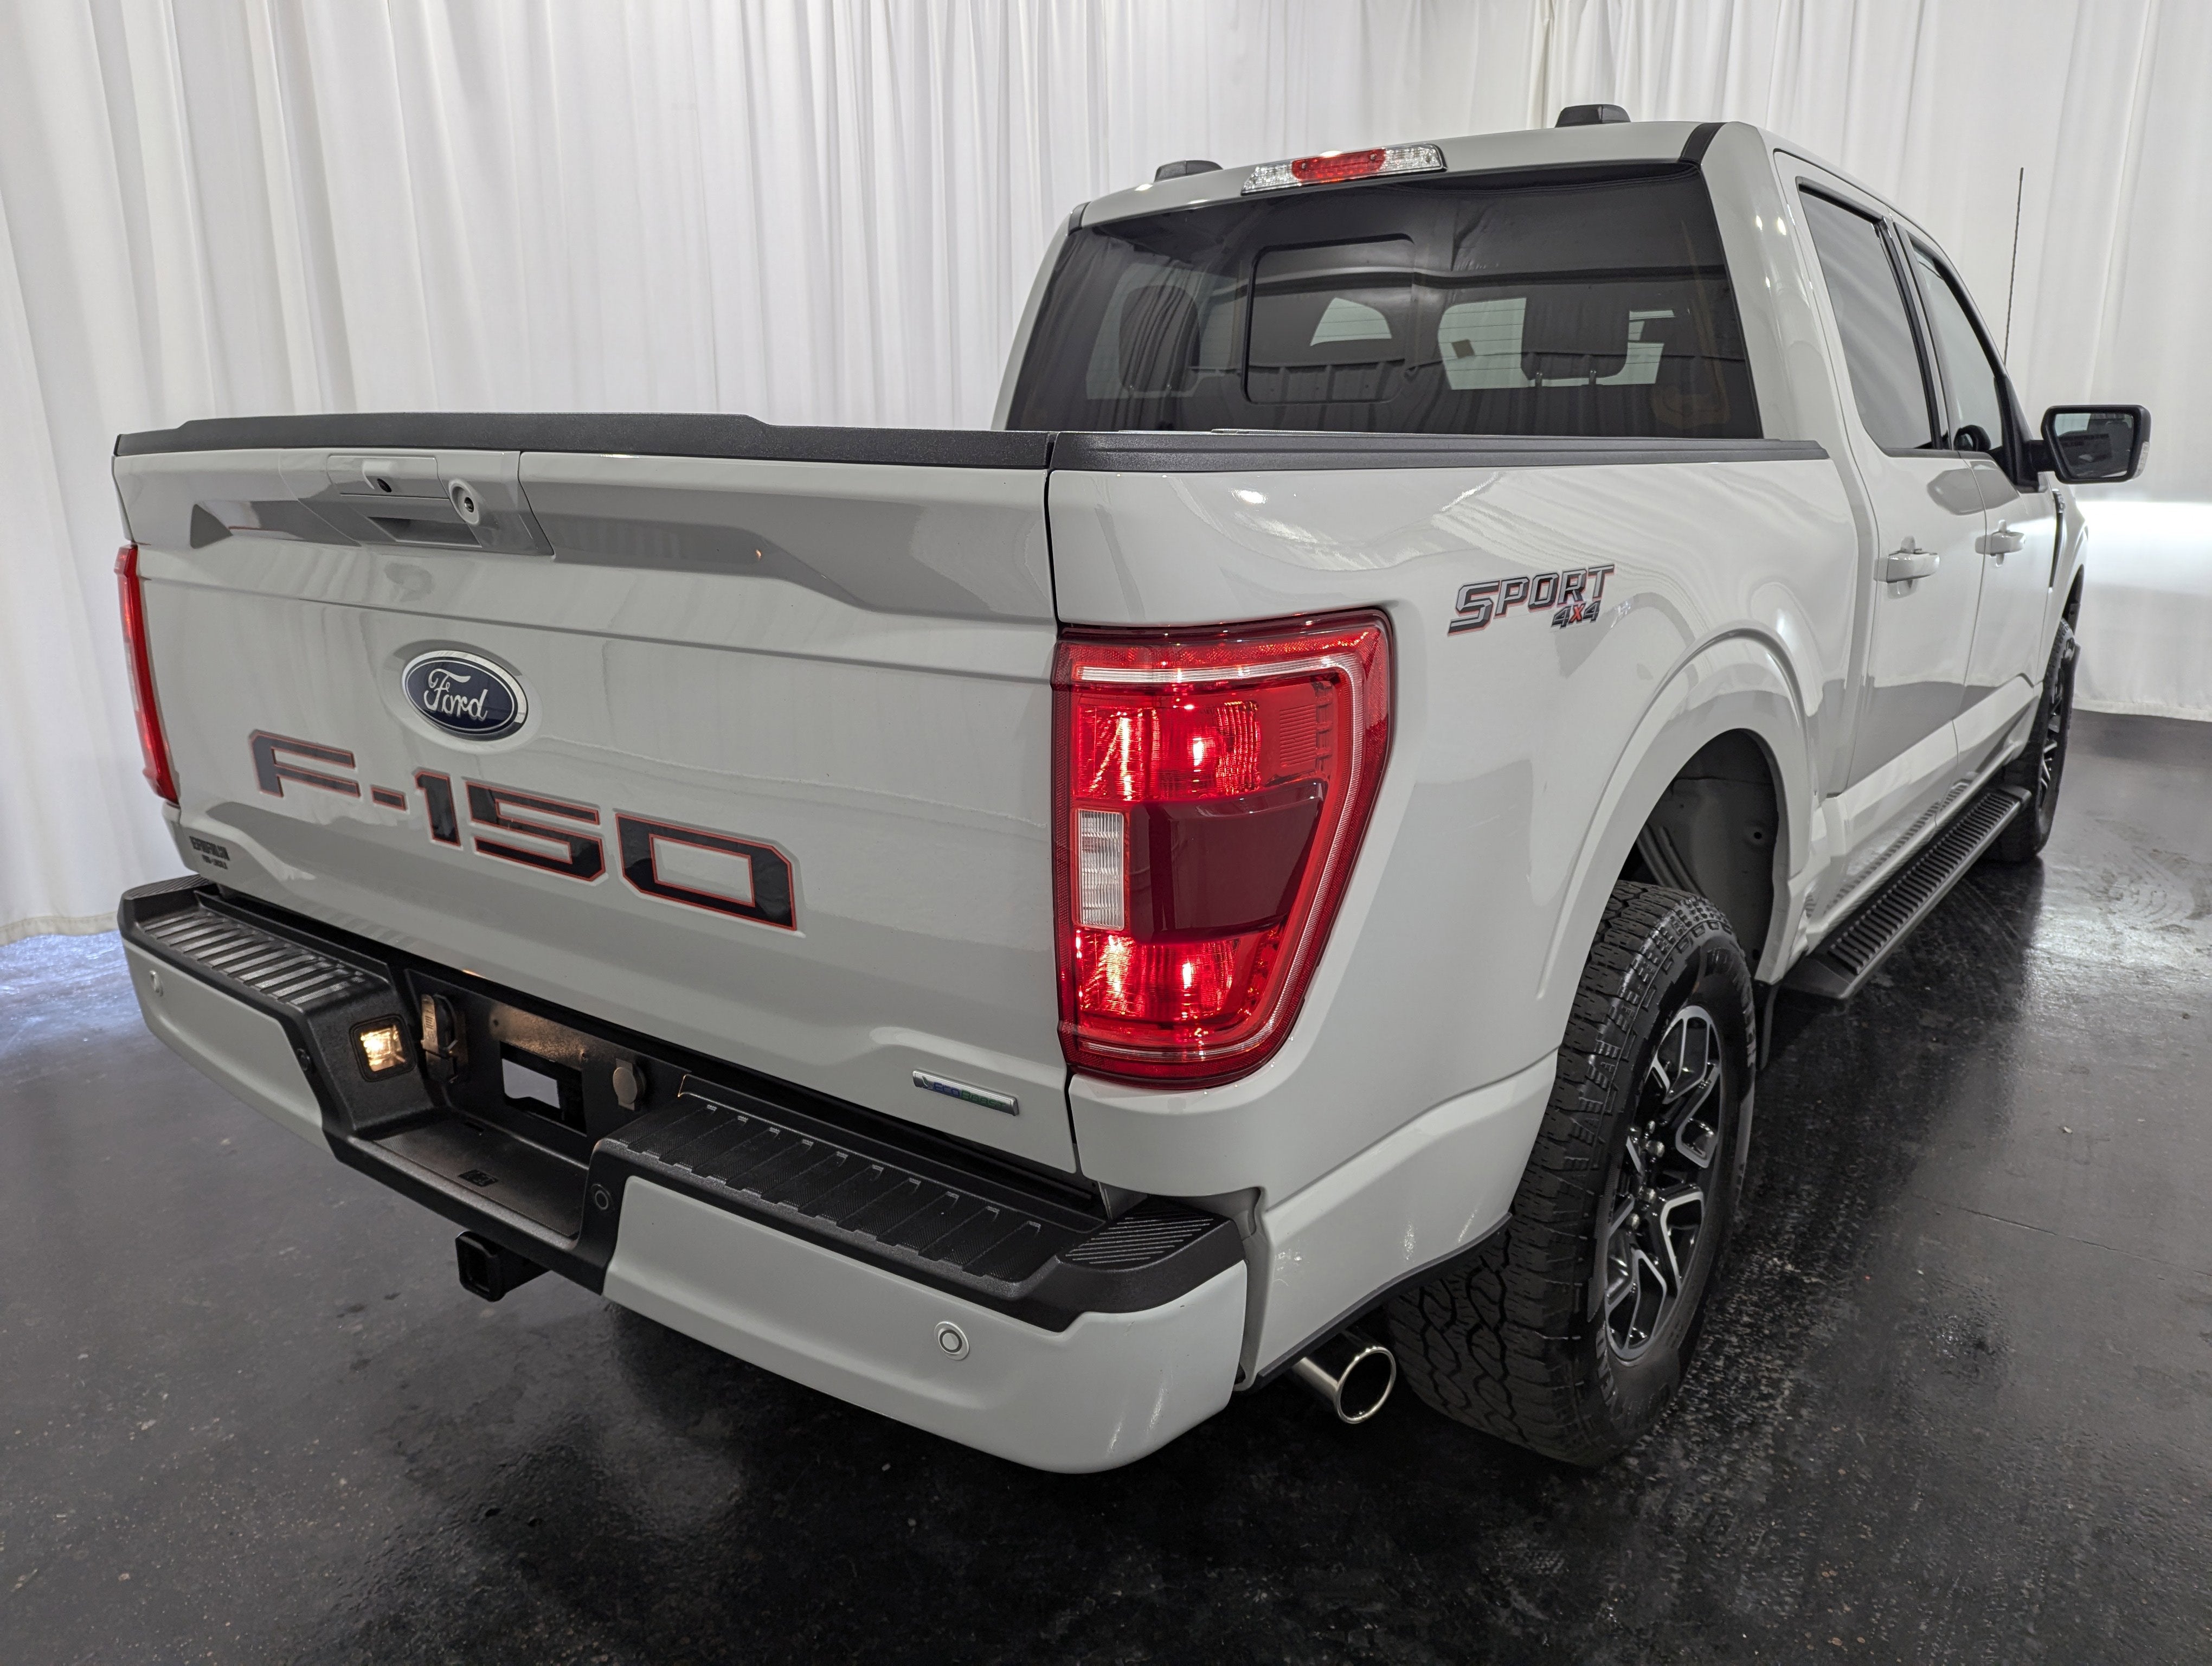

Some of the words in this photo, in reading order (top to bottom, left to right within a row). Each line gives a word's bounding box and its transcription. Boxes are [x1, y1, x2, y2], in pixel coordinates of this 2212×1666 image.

[1447, 563, 1615, 637] SPORT
[423, 668, 488, 721] Ford
[249, 730, 797, 931] F-150
